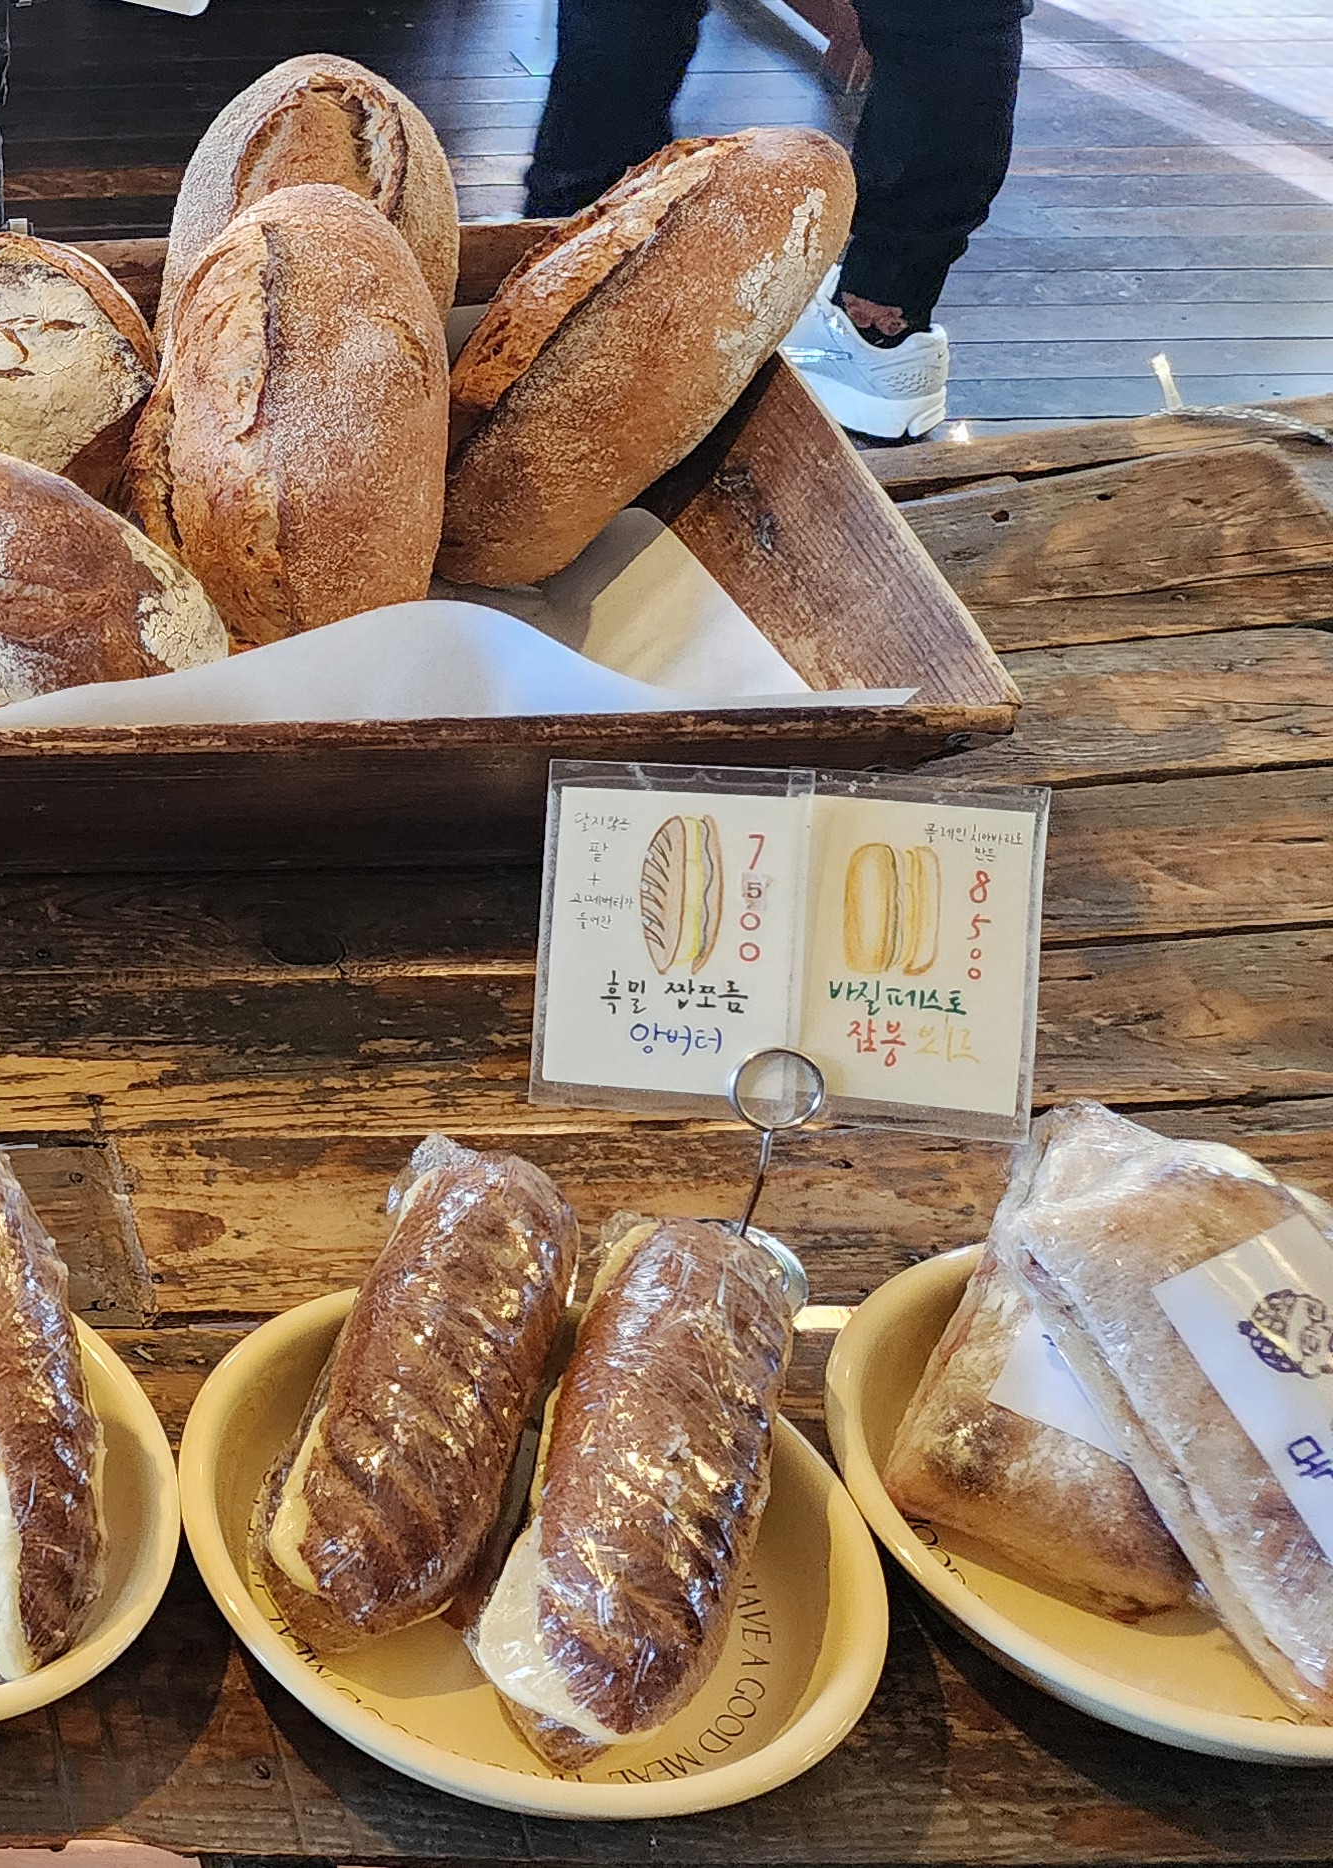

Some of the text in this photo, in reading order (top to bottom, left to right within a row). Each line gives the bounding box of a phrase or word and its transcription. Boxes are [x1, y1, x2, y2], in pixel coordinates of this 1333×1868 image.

[924, 822, 967, 844] 플레인
[588, 840, 609, 863] 팥
[974, 846, 997, 863] 만든
[575, 911, 613, 930] 들어간
[599, 969, 647, 1015] 흑밀
[629, 1022, 723, 1057] 앙버터
[846, 1018, 907, 1068] 잠봉
[740, 1648, 771, 1668] A
[698, 1677, 767, 1755] GOOD
[608, 1746, 705, 1785] MEAL
